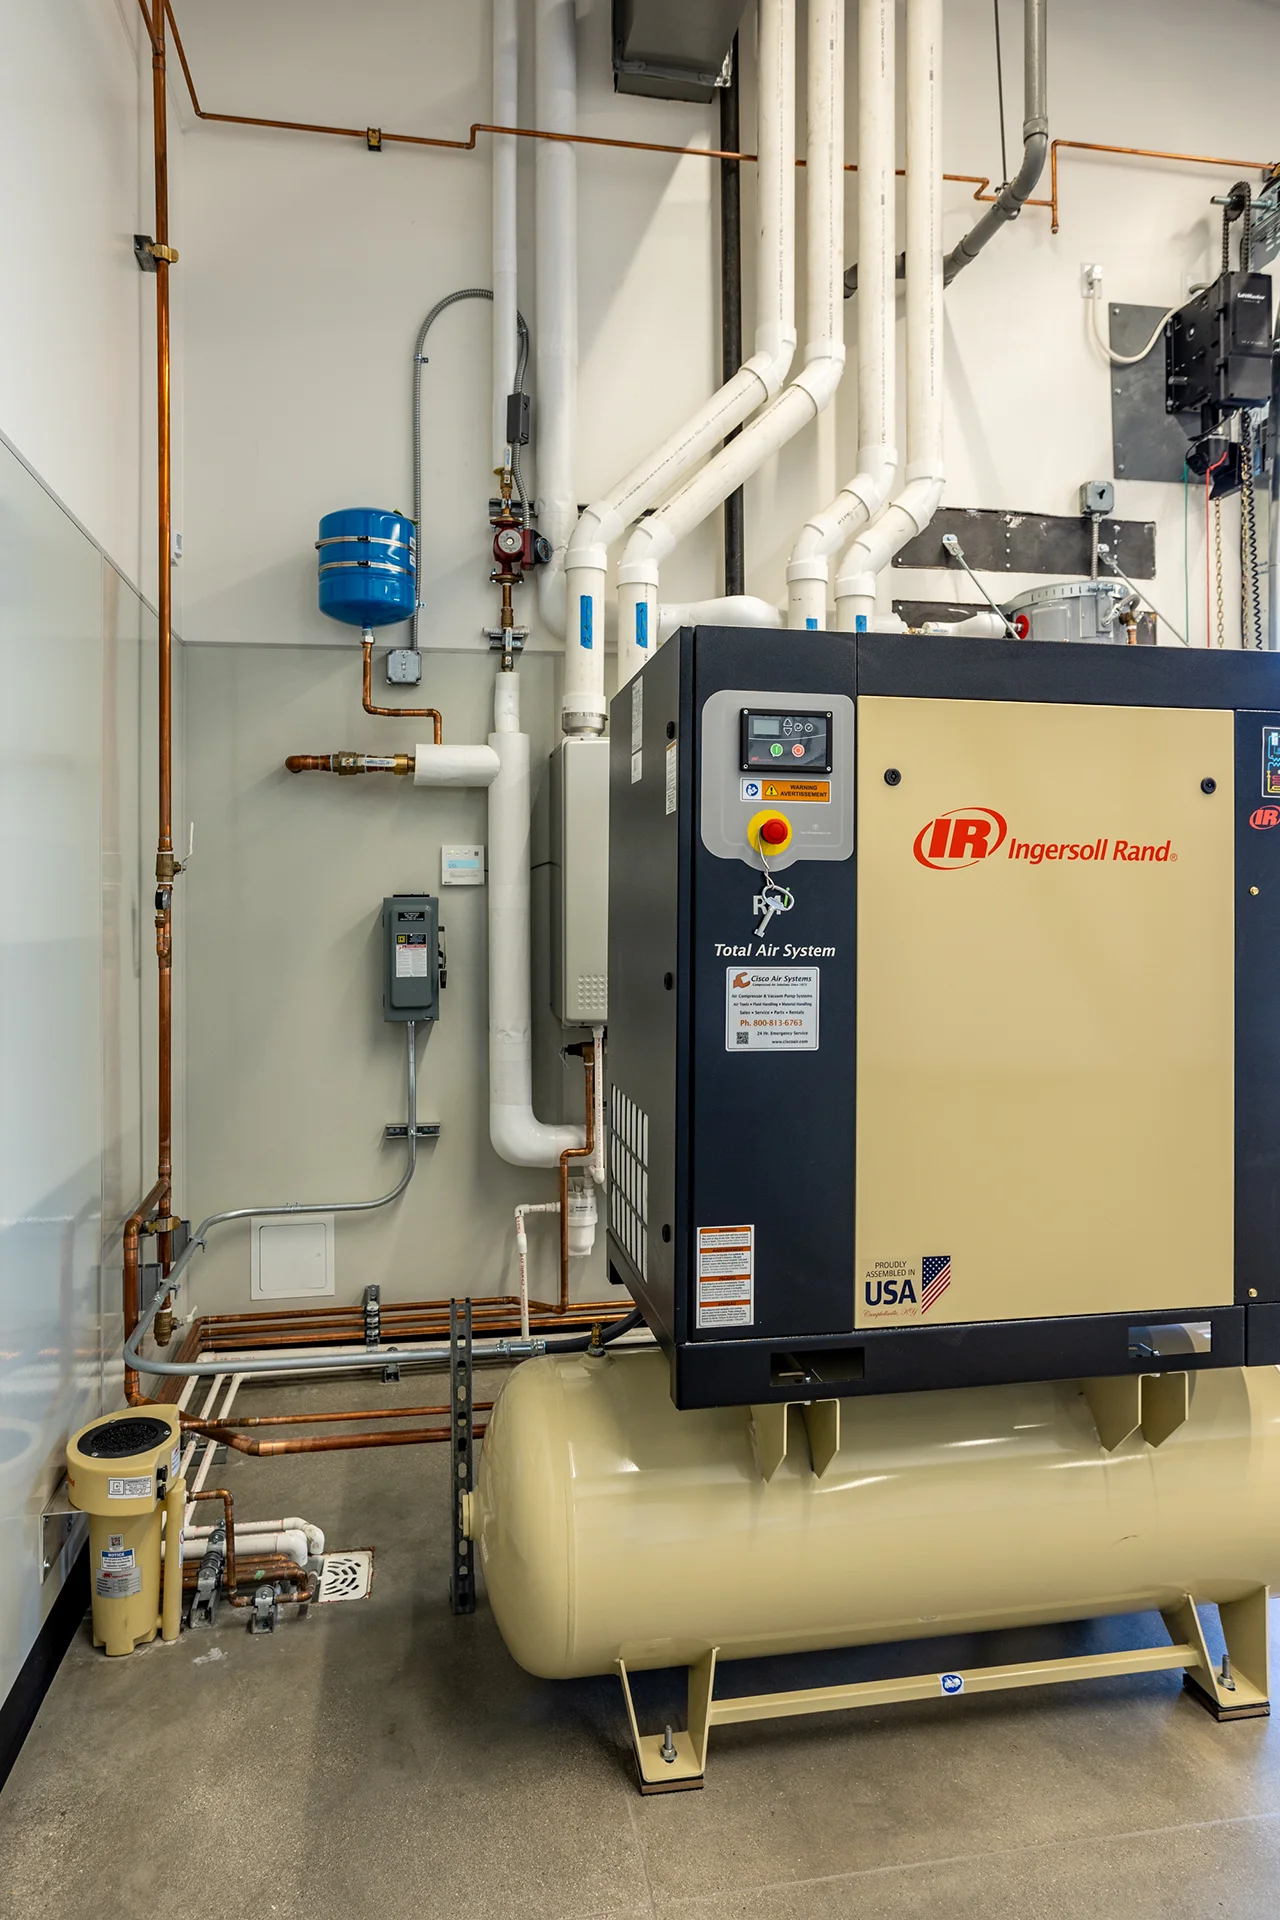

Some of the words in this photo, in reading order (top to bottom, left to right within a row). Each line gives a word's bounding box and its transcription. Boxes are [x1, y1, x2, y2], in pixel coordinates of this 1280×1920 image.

[928, 818, 992, 858] IR
[1008, 838, 1108, 864] Ingersoll
[714, 944, 752, 956] Total
[756, 944, 779, 956] Air
[783, 944, 836, 959] System
[865, 1280, 917, 1306] USA
